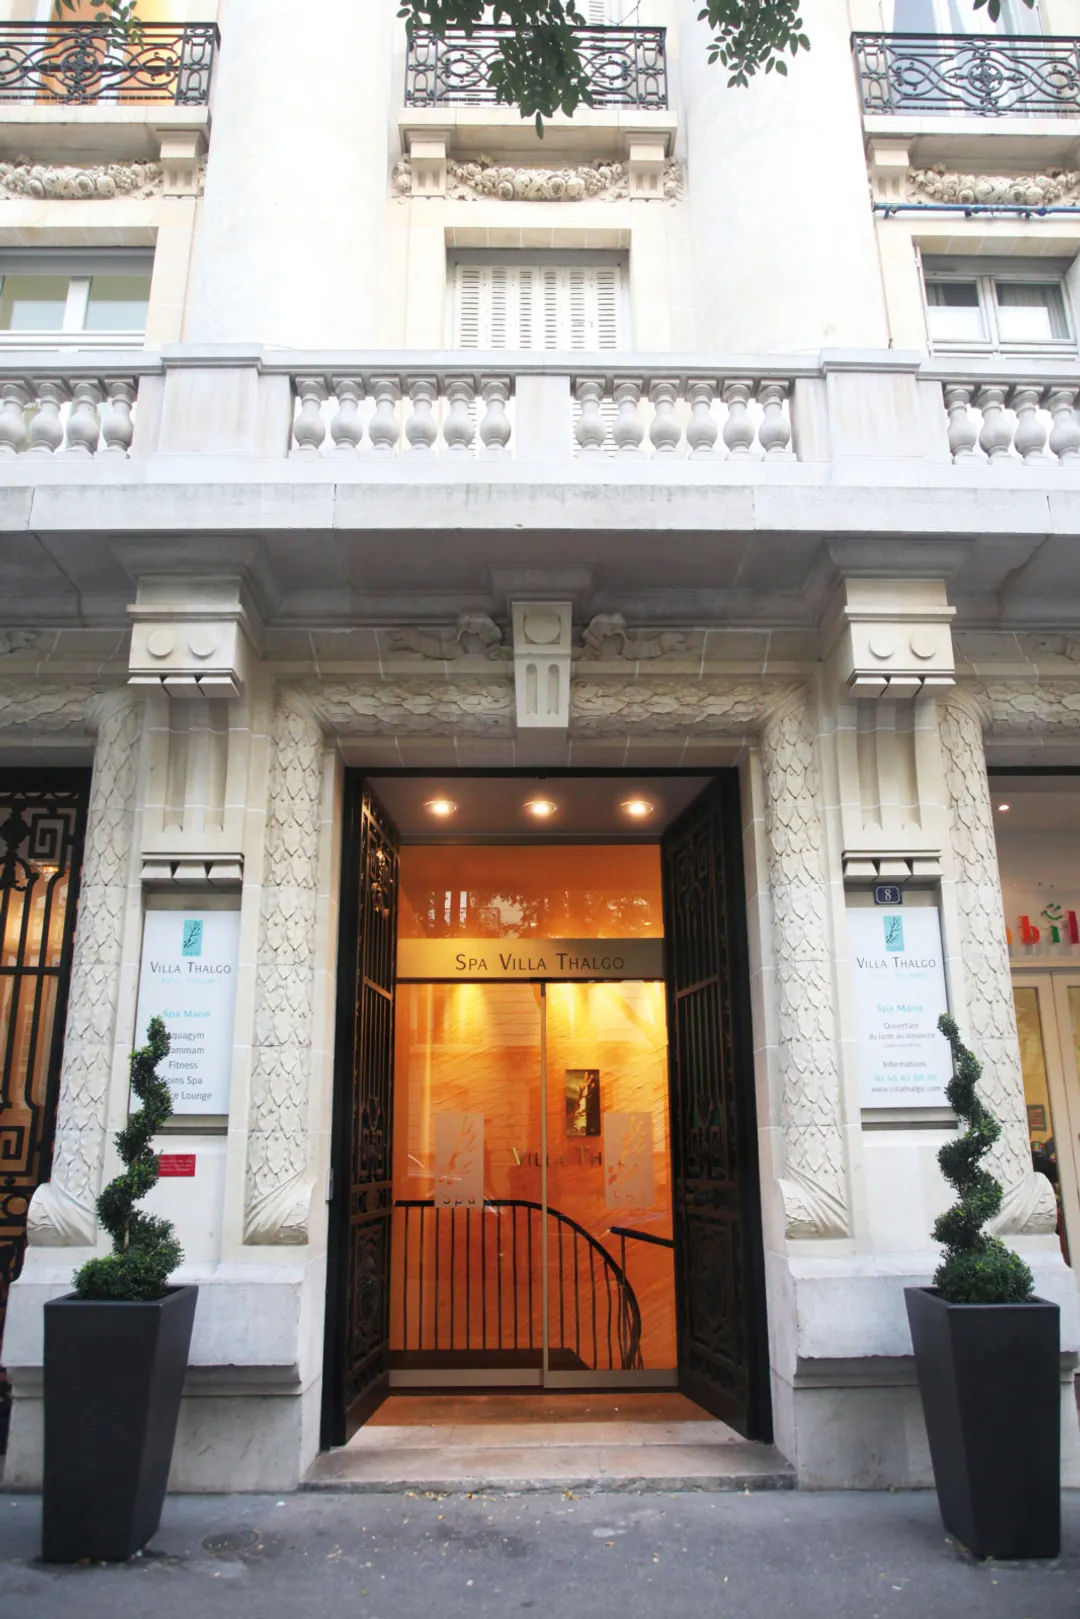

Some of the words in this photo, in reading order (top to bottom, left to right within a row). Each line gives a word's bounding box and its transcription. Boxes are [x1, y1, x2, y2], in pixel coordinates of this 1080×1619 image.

[884, 888, 892, 901] 8
[455, 953, 488, 971] SPA
[499, 953, 547, 971] VILLA
[556, 952, 625, 971] THALGO
[856, 957, 887, 969] VILLA
[892, 956, 937, 969] THALGO
[150, 961, 181, 974] VILLA
[187, 961, 232, 974] THALGO
[163, 1010, 180, 1019] Spa
[183, 1009, 211, 1018] Marin
[876, 1004, 894, 1014] Spa
[883, 1022, 919, 1030] Ouverture
[169, 1032, 205, 1041] quagym
[169, 1046, 205, 1055] ammam
[168, 1060, 198, 1070] Fitness
[186, 1075, 203, 1086] Spa
[181, 1091, 213, 1102] Lounge
